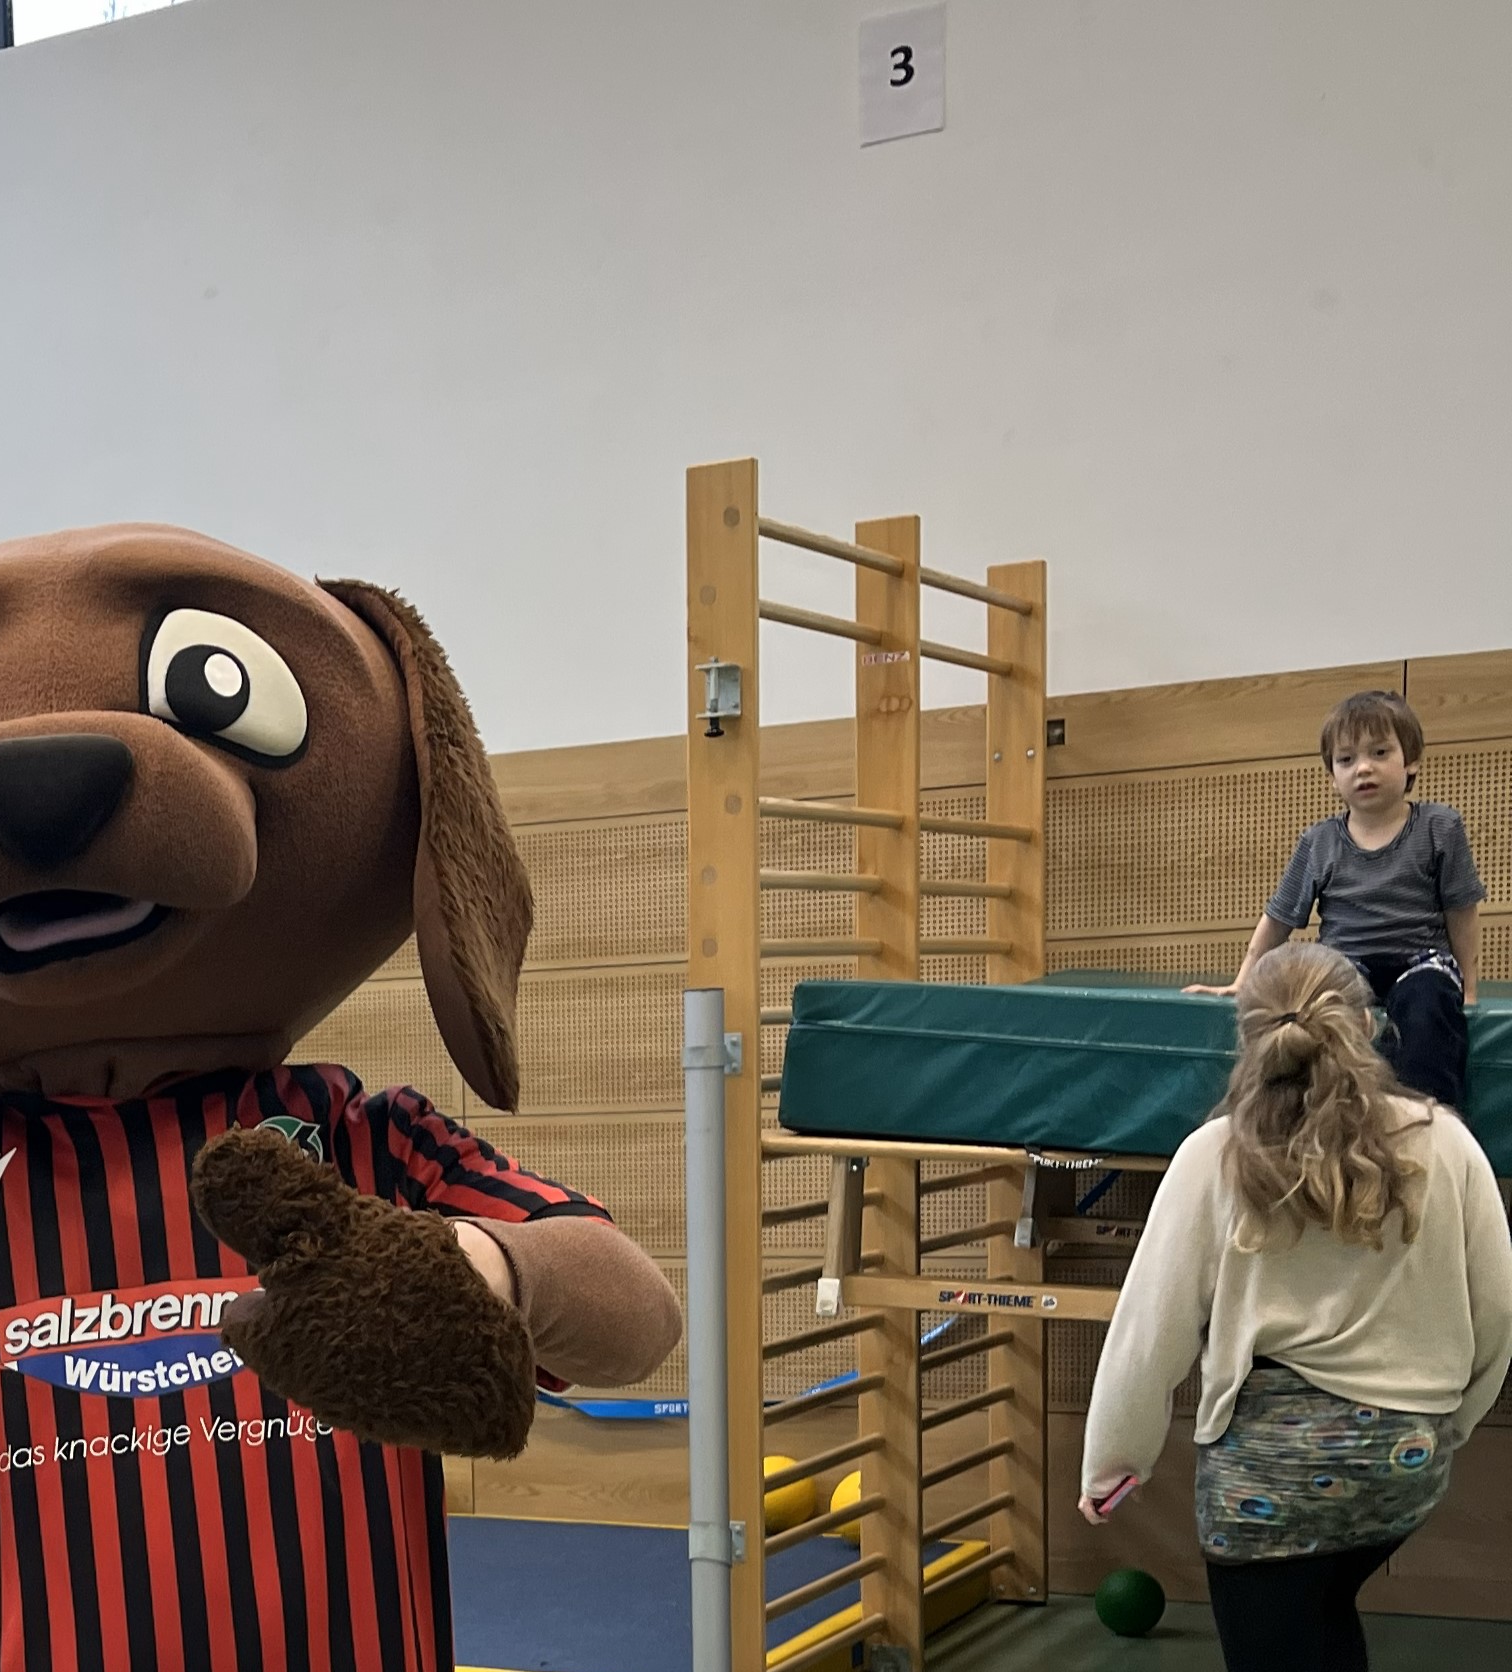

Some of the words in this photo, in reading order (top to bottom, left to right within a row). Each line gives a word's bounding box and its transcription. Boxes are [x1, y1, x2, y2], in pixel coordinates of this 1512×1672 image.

[889, 45, 915, 87] 3
[938, 1289, 1035, 1308] SPORT-THIEME
[3, 1288, 265, 1355] salzbrenn
[54, 1424, 192, 1461] knackige
